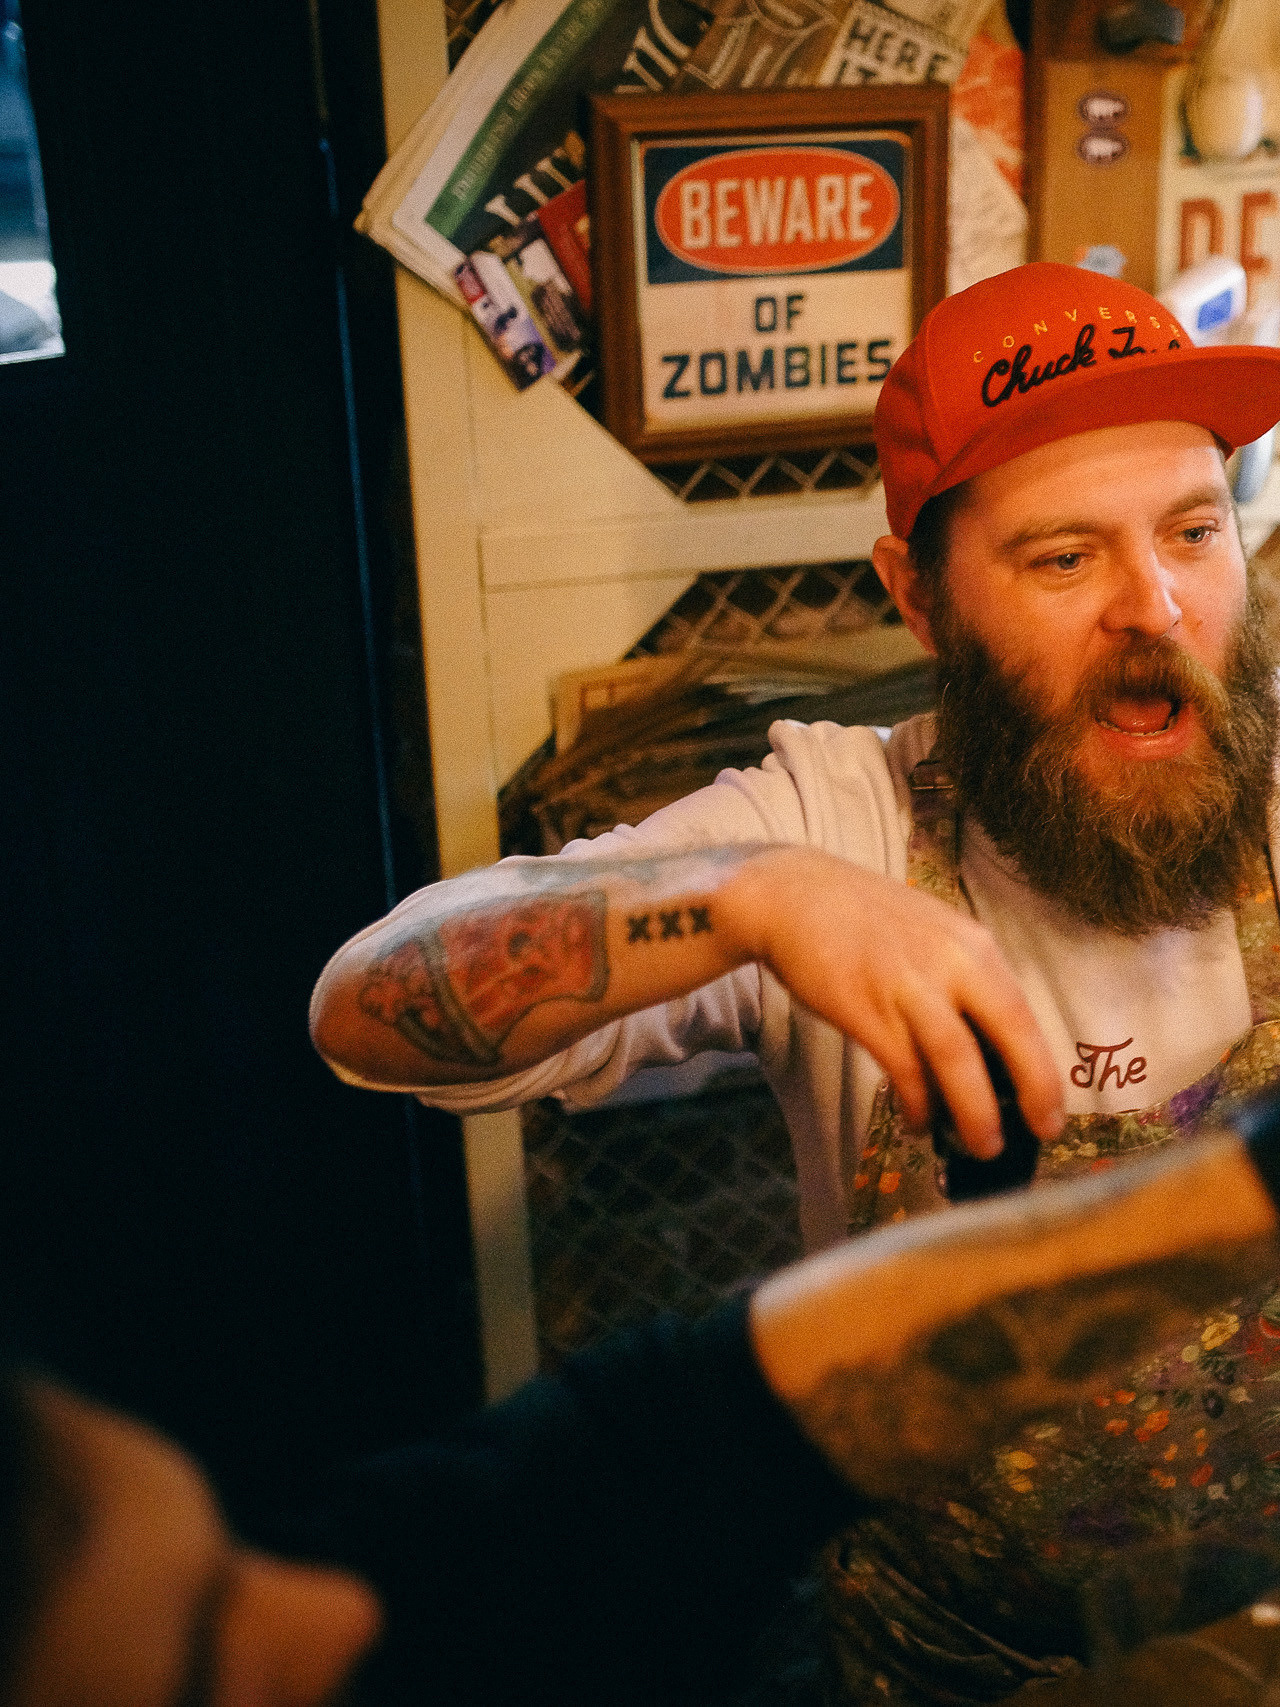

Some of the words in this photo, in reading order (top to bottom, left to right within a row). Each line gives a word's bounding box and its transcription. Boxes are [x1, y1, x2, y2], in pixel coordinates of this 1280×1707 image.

[679, 172, 876, 250] BEWARE
[754, 294, 805, 333] OF
[661, 340, 894, 399] ZOMBIES
[981, 323, 1098, 409] Chuck
[1070, 1037, 1149, 1090] The
